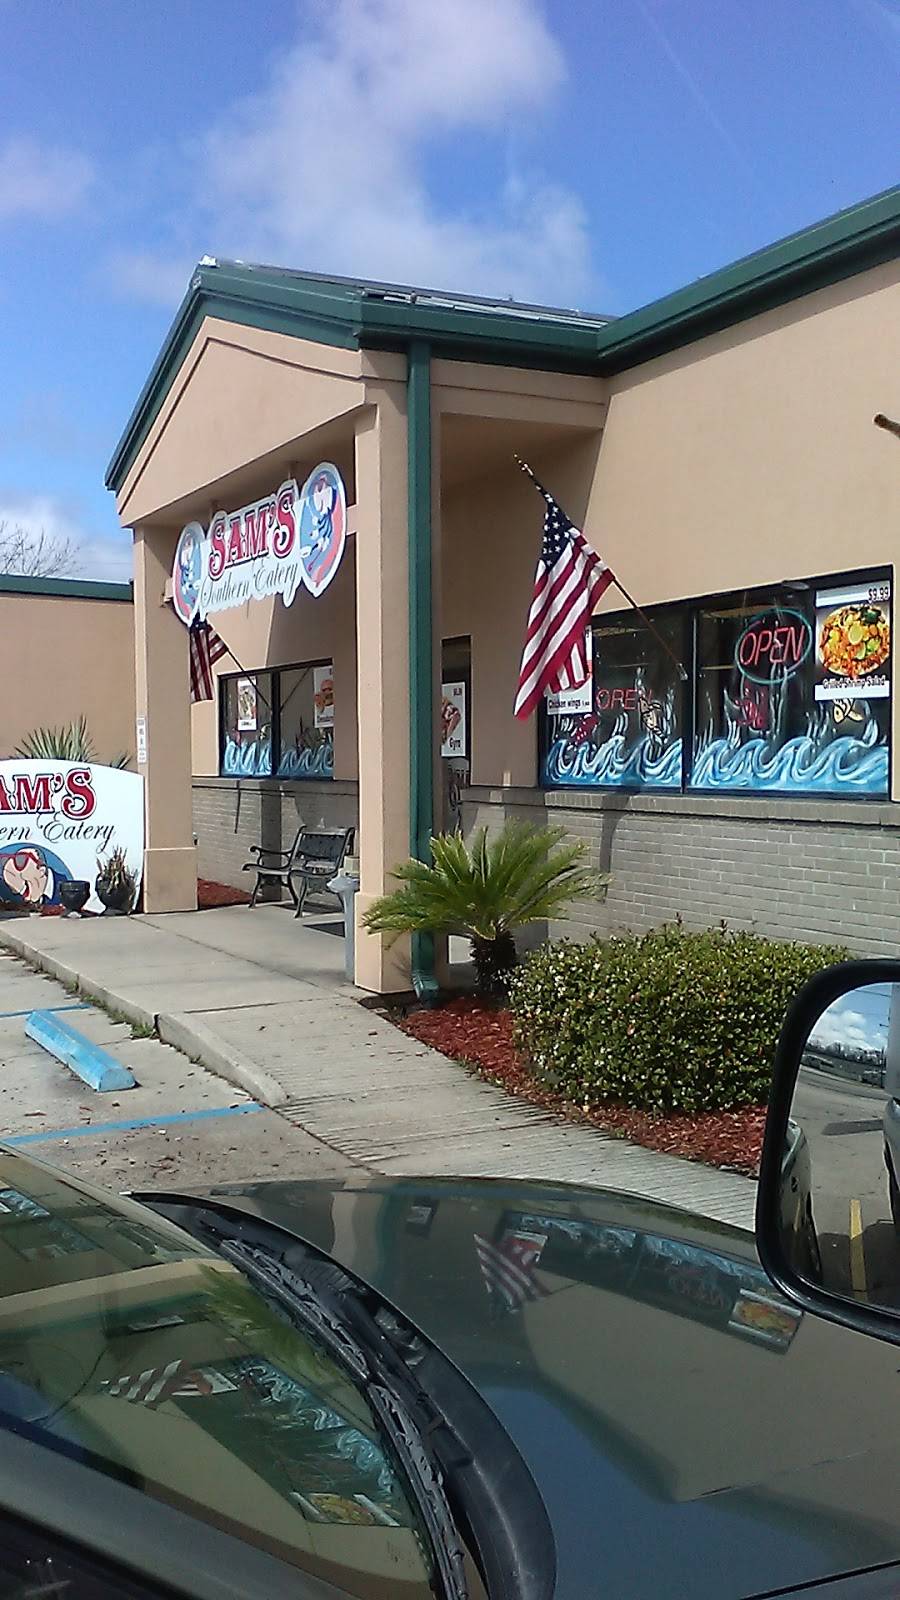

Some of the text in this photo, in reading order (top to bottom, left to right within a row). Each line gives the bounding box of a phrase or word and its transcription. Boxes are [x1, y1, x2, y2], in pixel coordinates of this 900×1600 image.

[208, 485, 296, 581] SAM'S
[200, 559, 299, 608] Southern Eatery
[739, 625, 806, 666] OPEN
[844, 677, 866, 690] Shrimp
[867, 675, 886, 688] Salad
[37, 812, 116, 854] Eatery
